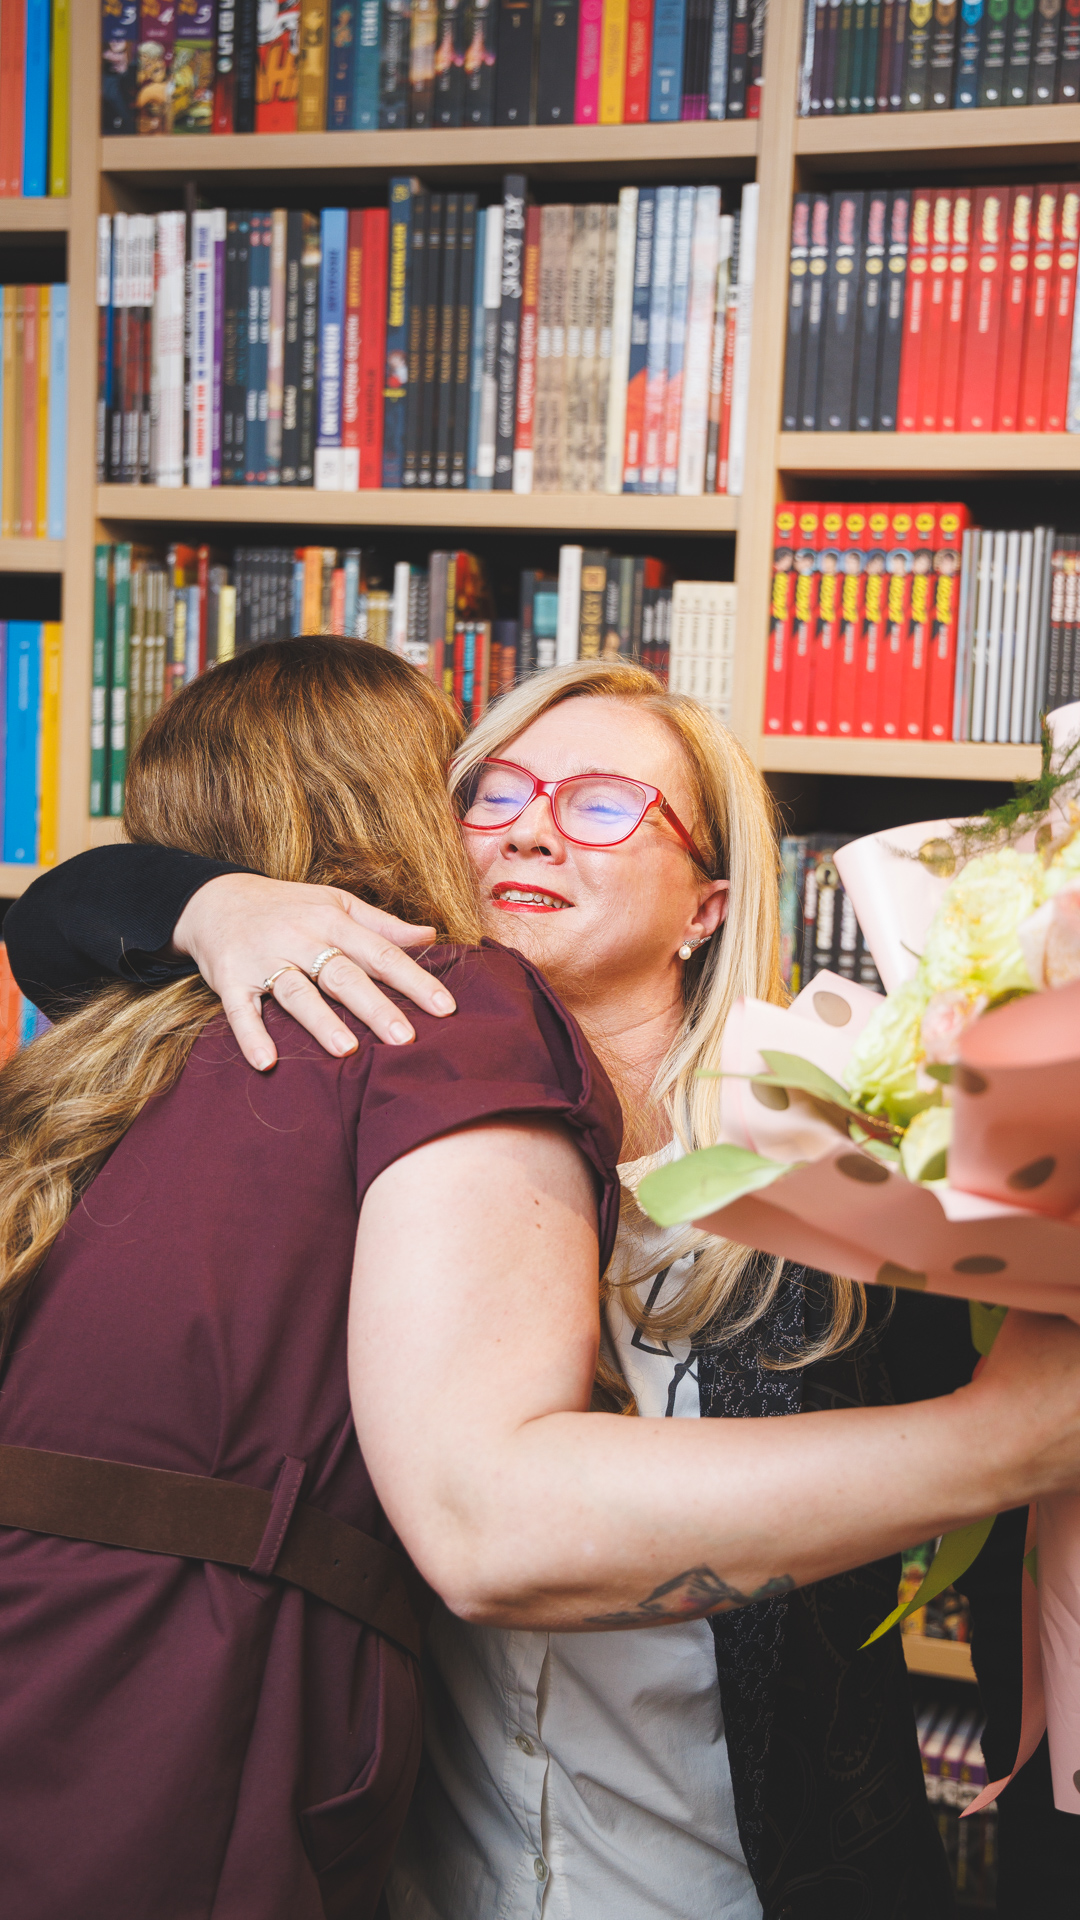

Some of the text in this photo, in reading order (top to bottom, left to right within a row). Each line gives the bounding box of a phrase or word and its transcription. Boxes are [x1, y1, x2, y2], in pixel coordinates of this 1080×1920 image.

[120, 6, 137, 25] 3
[503, 194, 525, 229] BOY
[772, 573, 789, 621] ZAGOR
[794, 574, 811, 623] ZAGOR
[819, 575, 836, 623] ZAGOR
[842, 576, 859, 623] ZAGOR
[864, 575, 882, 624] ZAGOR
[887, 575, 905, 624] ZAGOR
[911, 576, 928, 624] ZAGOR
[935, 575, 952, 625] ZAGOR
